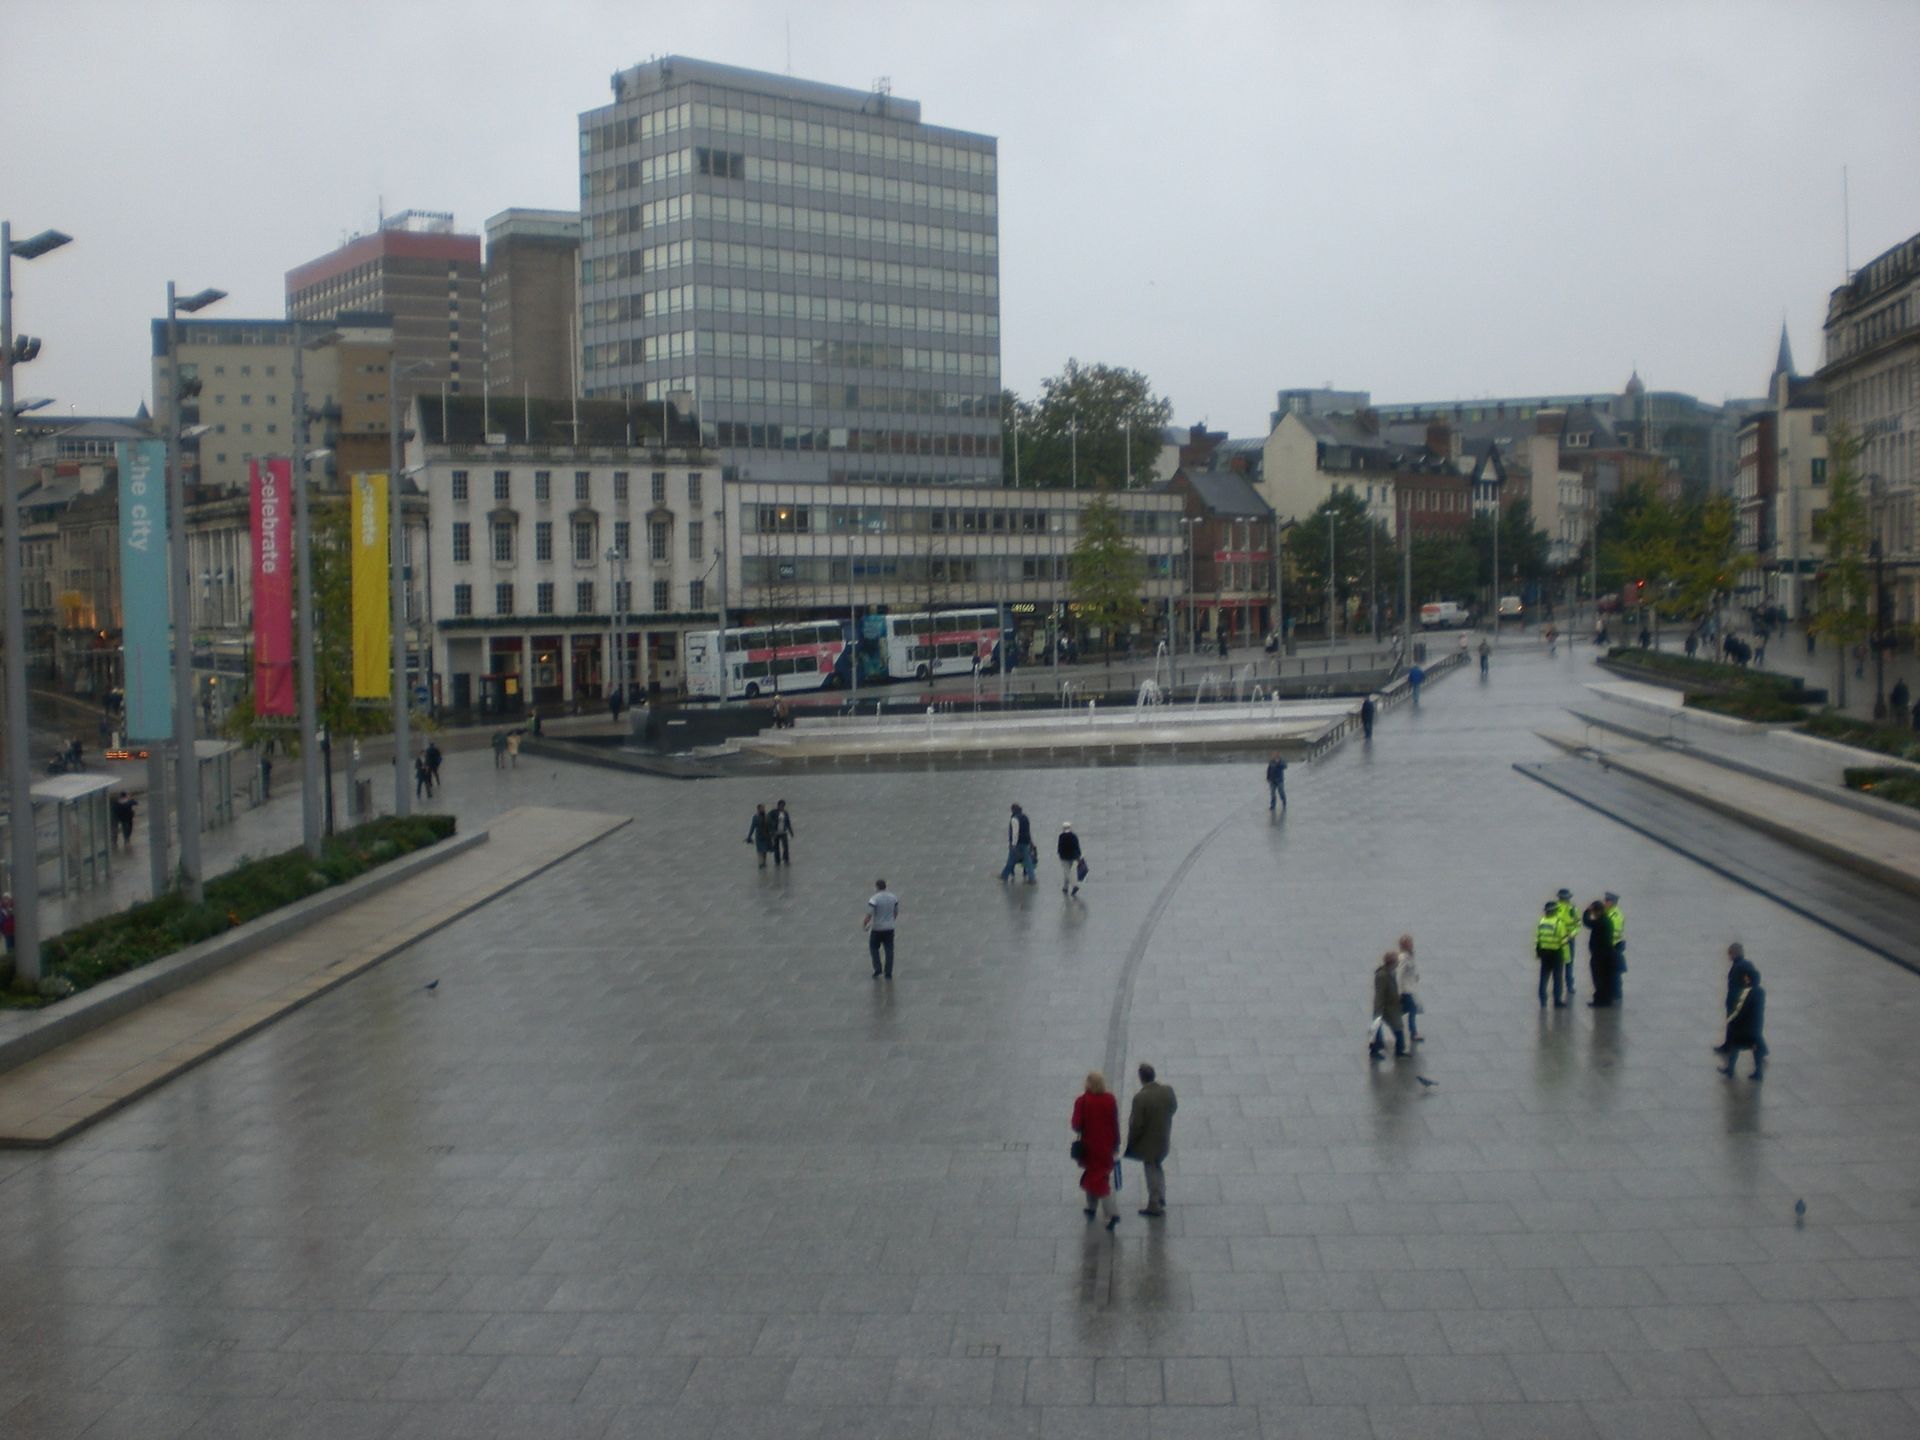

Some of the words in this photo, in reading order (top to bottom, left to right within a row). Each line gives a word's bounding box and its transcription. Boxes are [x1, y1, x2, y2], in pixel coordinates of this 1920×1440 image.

[131, 455, 151, 496] the
[128, 504, 152, 551] city
[261, 472, 279, 574] celebrate
